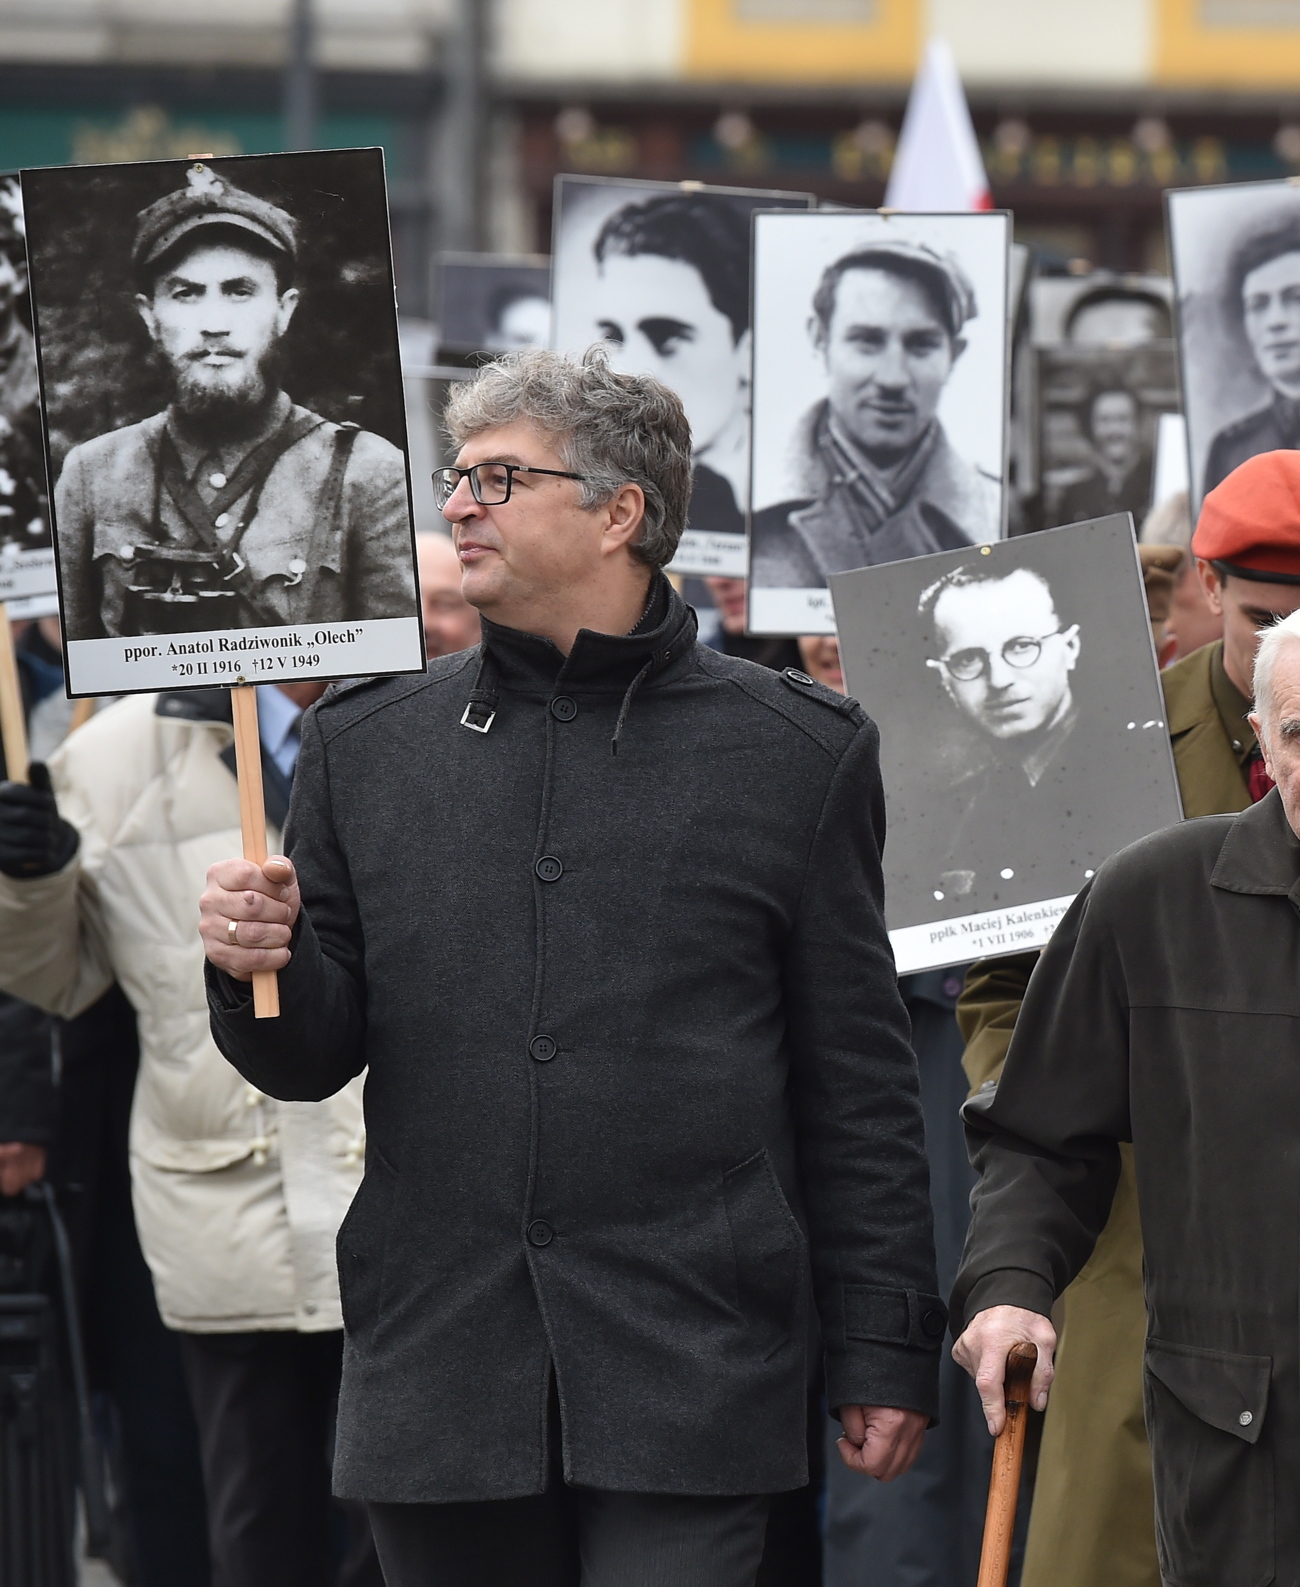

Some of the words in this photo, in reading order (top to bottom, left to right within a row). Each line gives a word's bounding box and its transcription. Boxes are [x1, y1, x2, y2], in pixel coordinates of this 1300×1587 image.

[124, 646, 162, 662] ppor.
[166, 639, 215, 656] Anatol
[218, 632, 302, 652] Radziwonik
[306, 628, 363, 649] „Olech”
[197, 662, 208, 675] II
[212, 659, 241, 673] 1916
[277, 656, 287, 669] V
[292, 653, 320, 668] 1949
[961, 916, 1002, 933] Maciej
[1005, 905, 1069, 926] Kalenkiew
[987, 933, 1006, 945] VII
[1009, 928, 1034, 942] 1906
